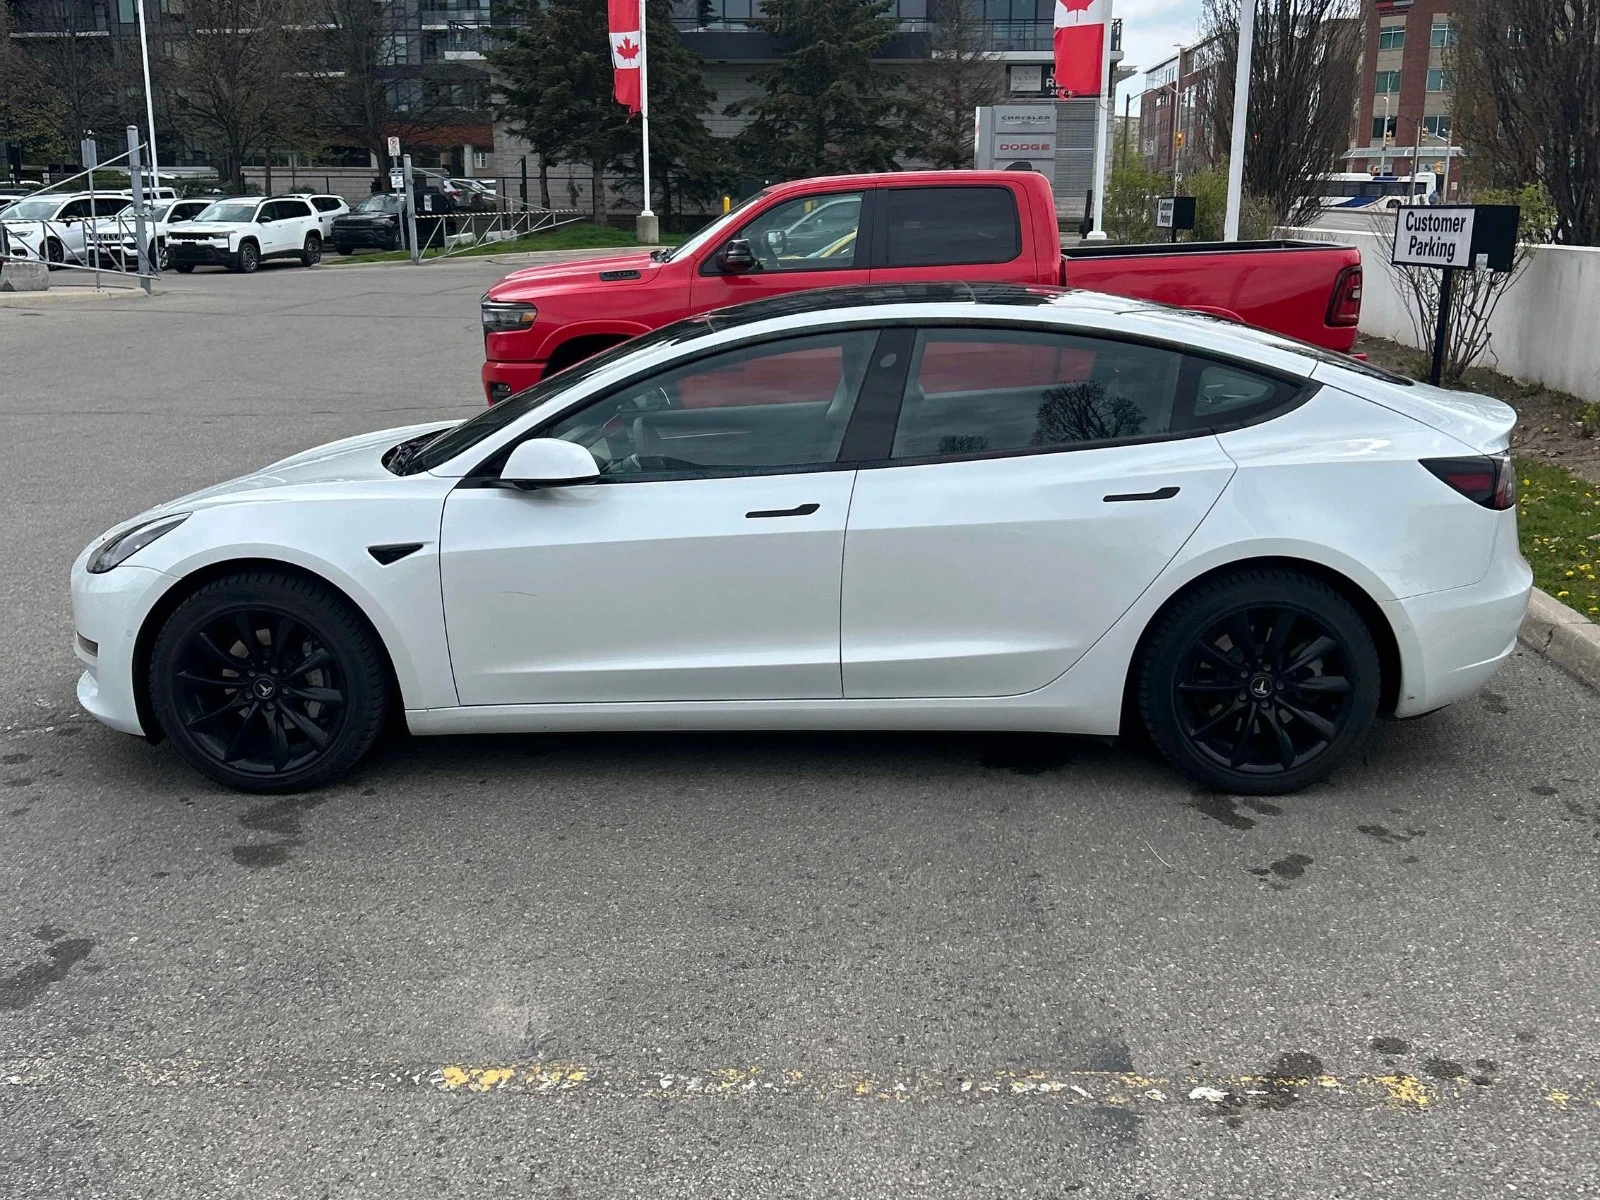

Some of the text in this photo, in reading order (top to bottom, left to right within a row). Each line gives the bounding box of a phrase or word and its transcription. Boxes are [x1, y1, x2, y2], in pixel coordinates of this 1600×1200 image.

[1000, 143, 1050, 151] DODGE
[1405, 211, 1466, 233] Customer
[1408, 235, 1456, 263] Parking
